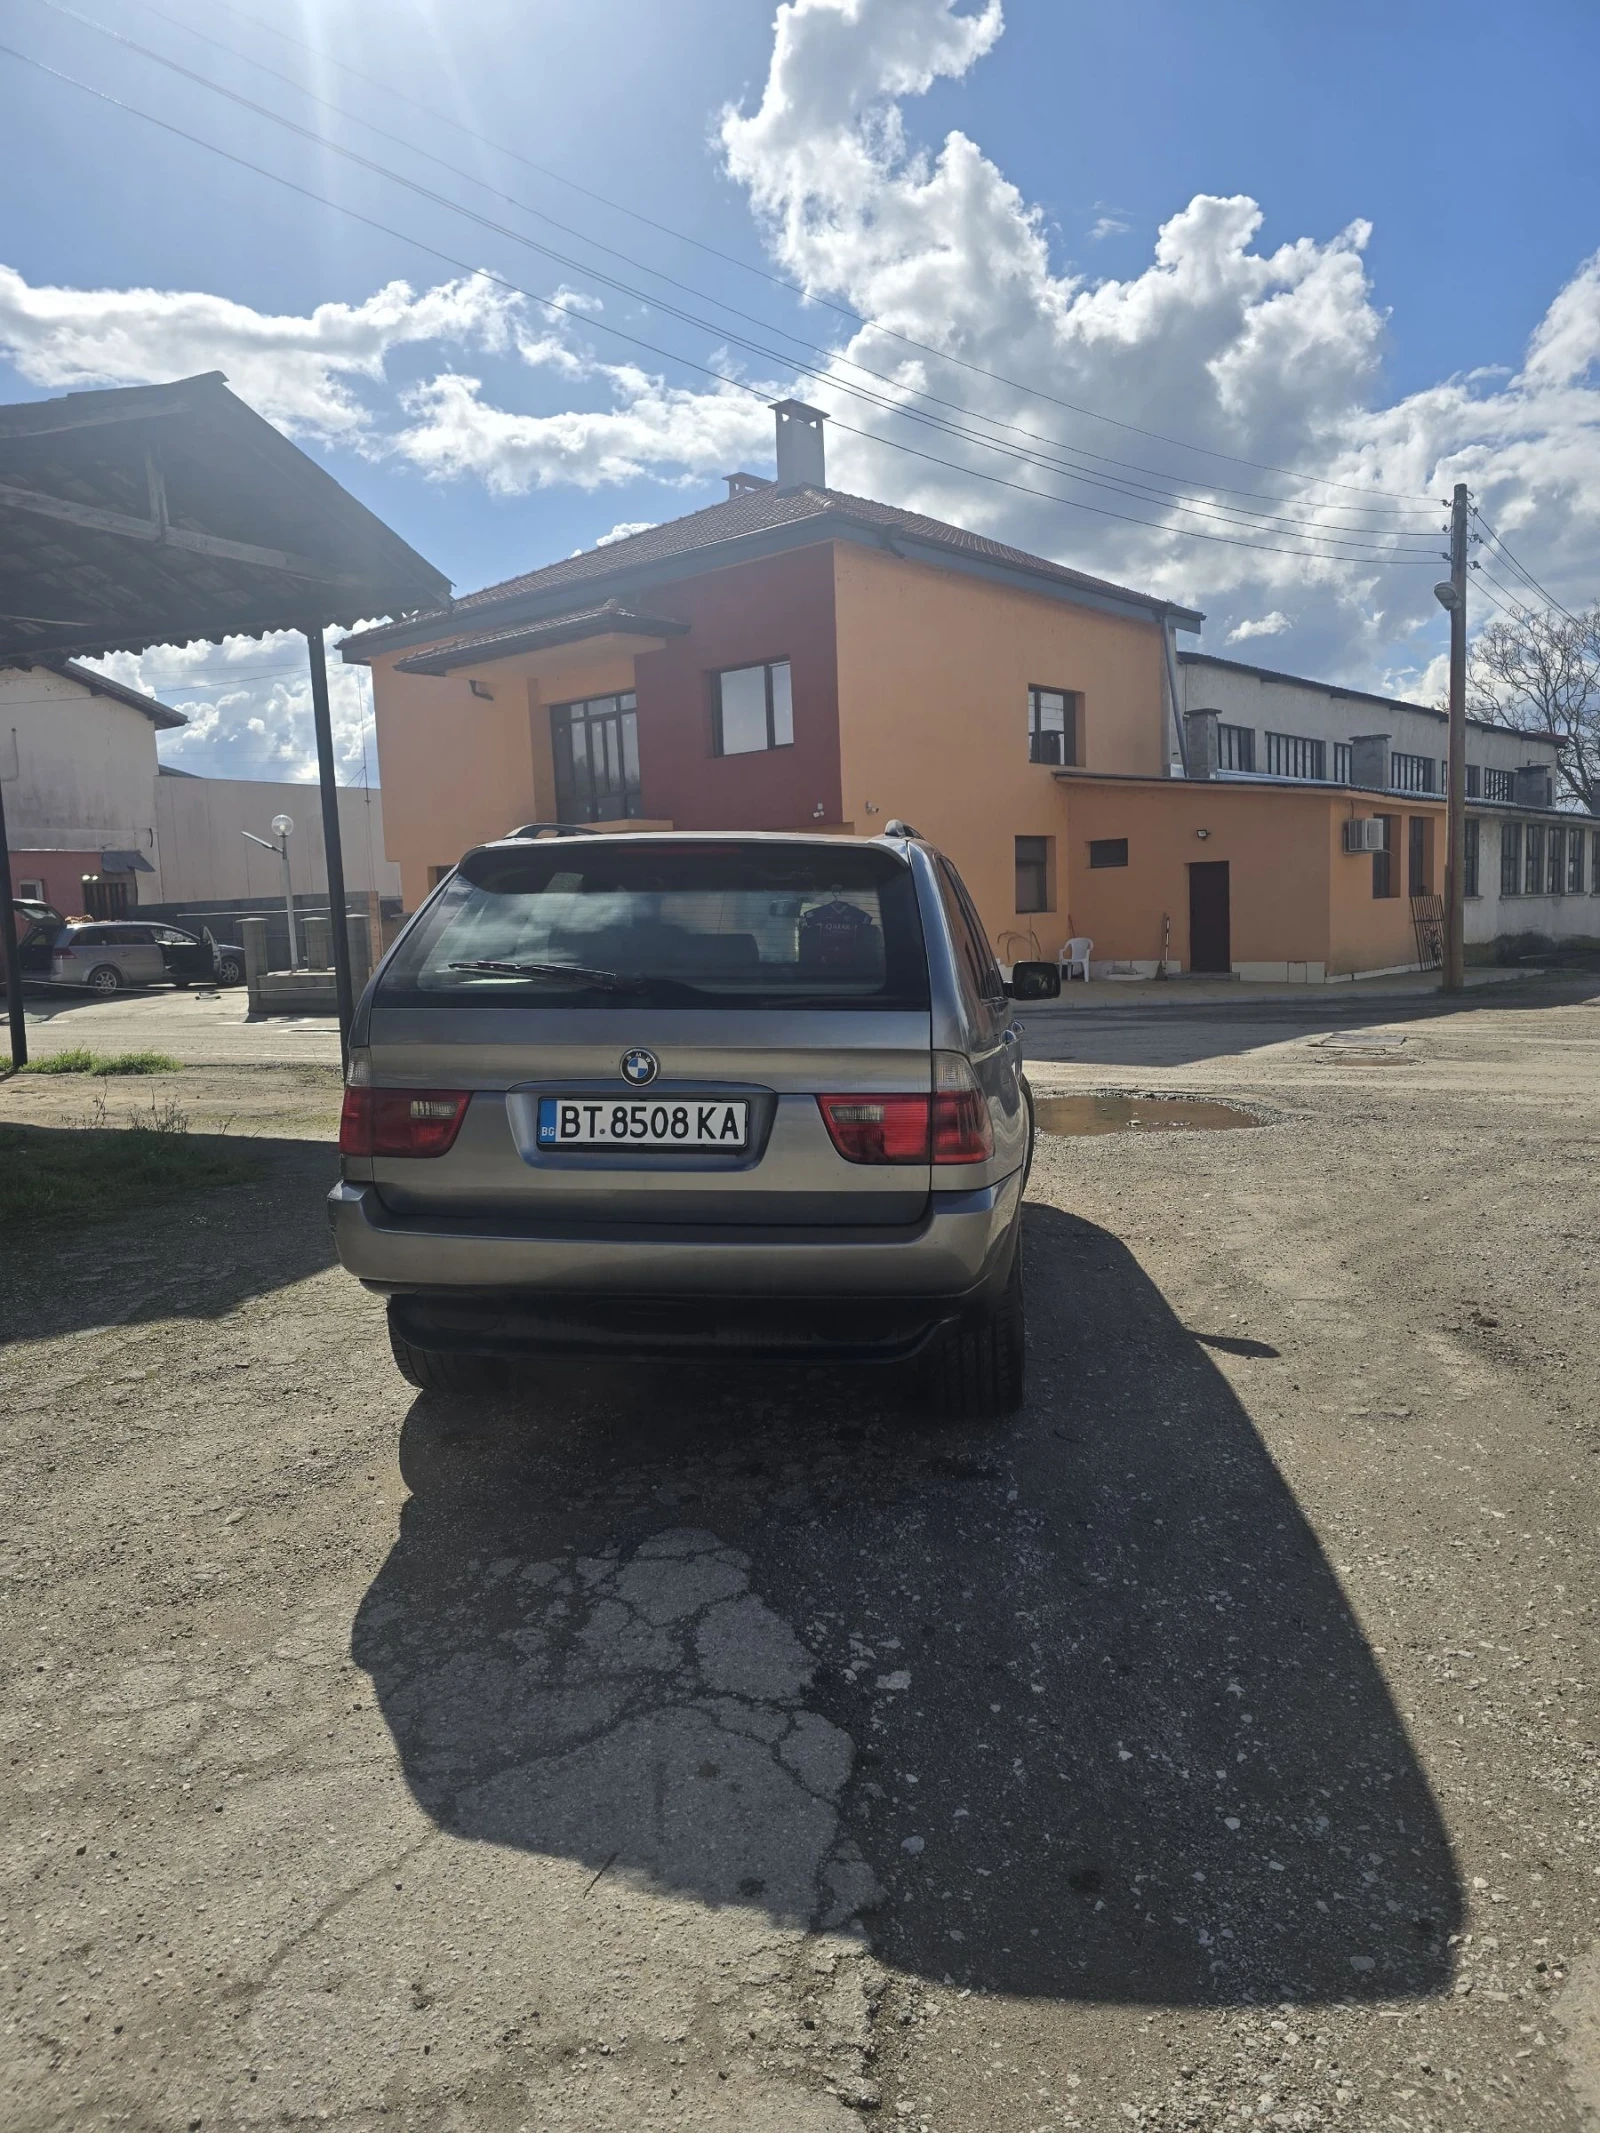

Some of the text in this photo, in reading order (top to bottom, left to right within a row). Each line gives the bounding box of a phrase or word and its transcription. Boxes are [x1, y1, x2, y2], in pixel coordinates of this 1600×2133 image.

[626, 1052, 653, 1063] BMW
[610, 1106, 689, 1139] 8508
[697, 1107, 739, 1139] KA
[541, 1126, 555, 1136] BG
